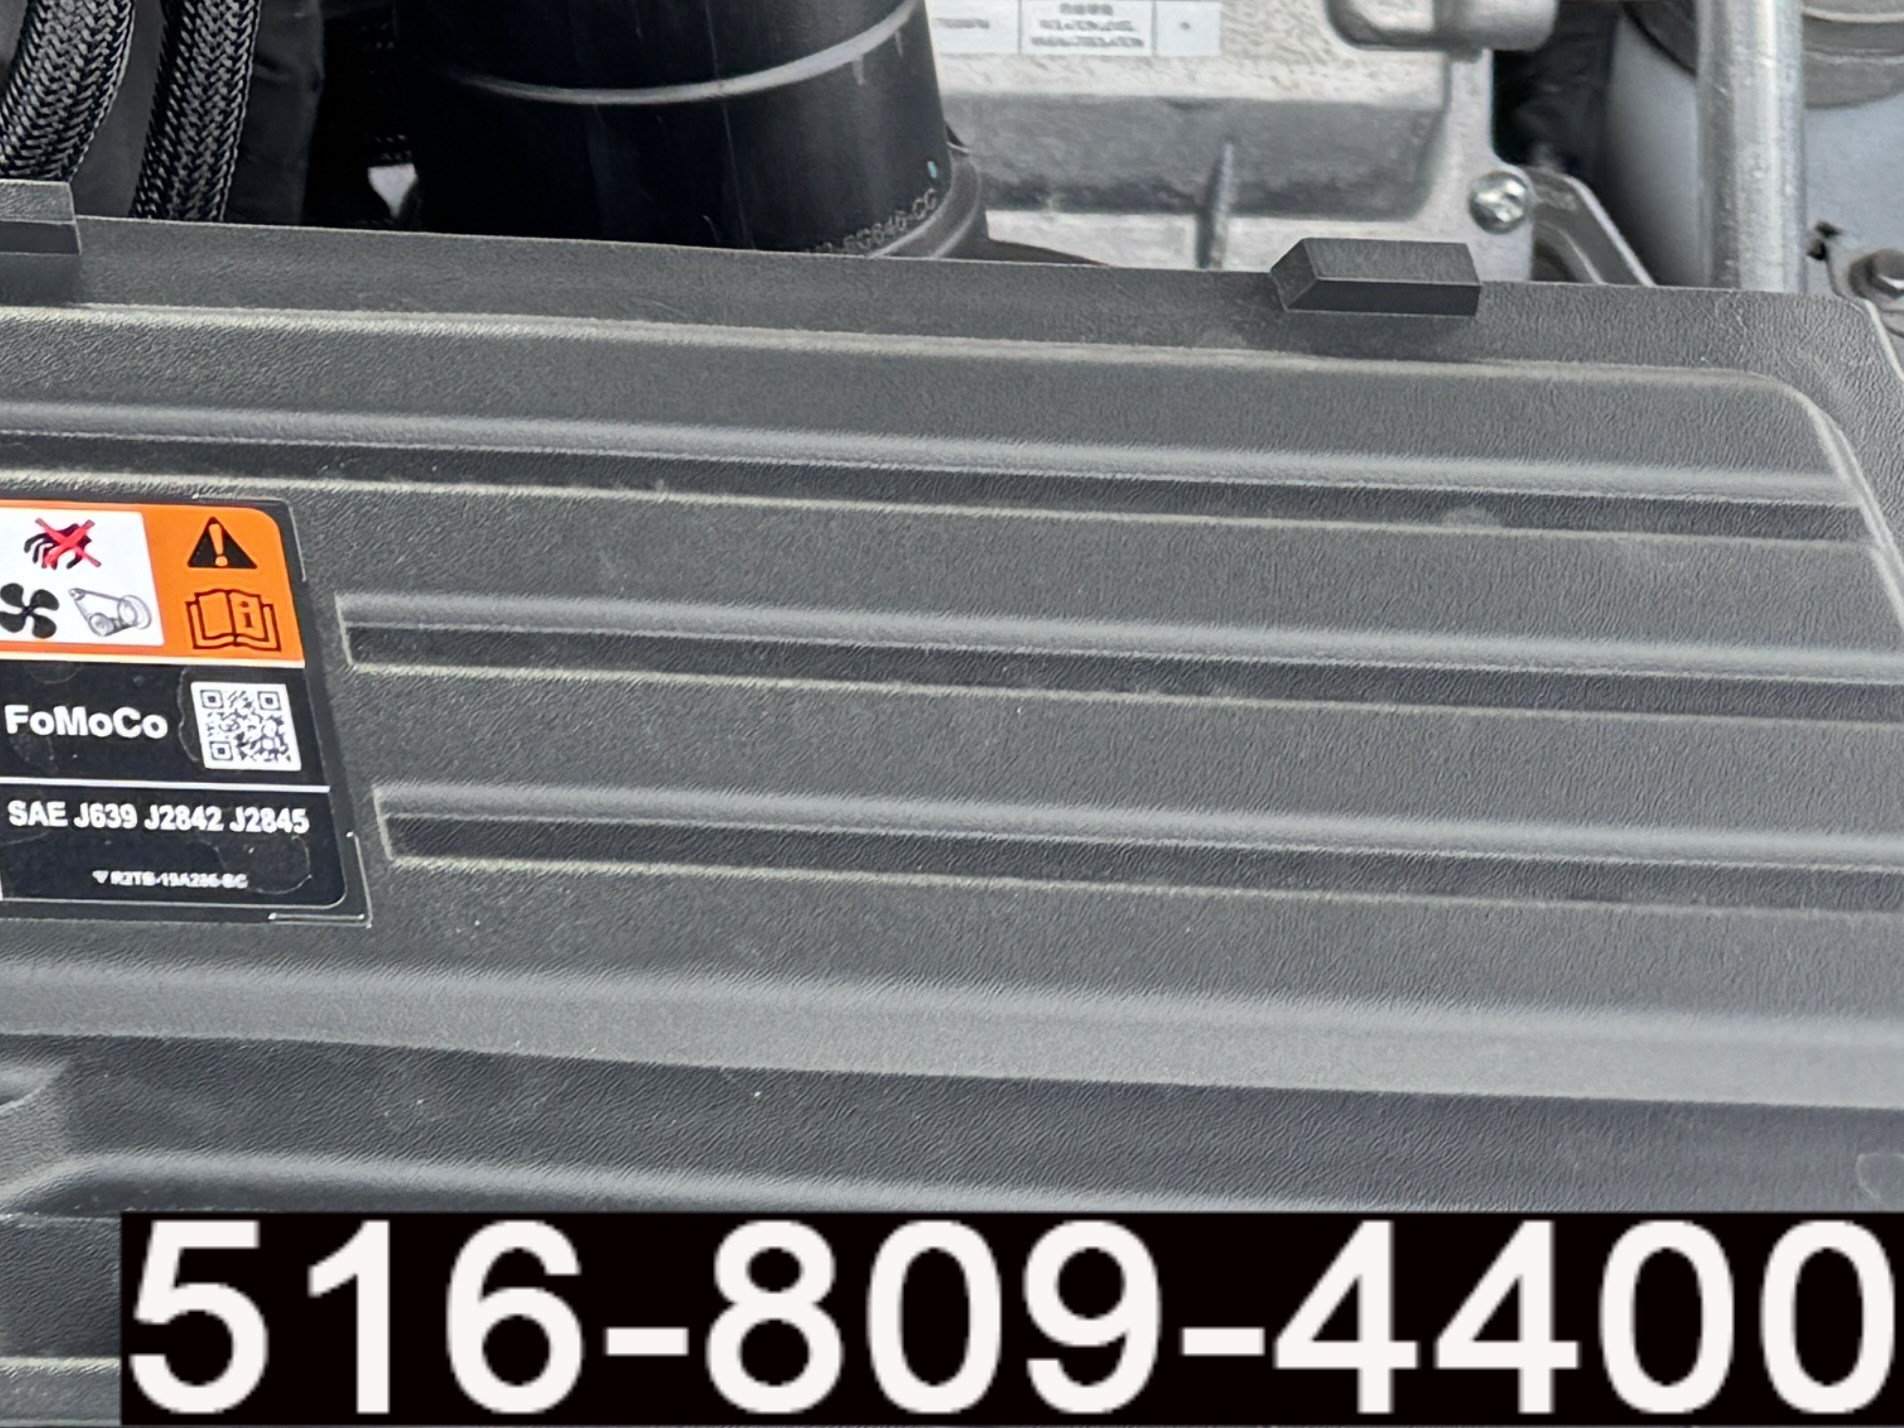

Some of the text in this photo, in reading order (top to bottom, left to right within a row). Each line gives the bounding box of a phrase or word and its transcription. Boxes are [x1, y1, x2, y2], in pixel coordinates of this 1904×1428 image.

[4, 704, 169, 740] FoMoCo
[7, 799, 310, 834] SAE J639 J2842 J2845
